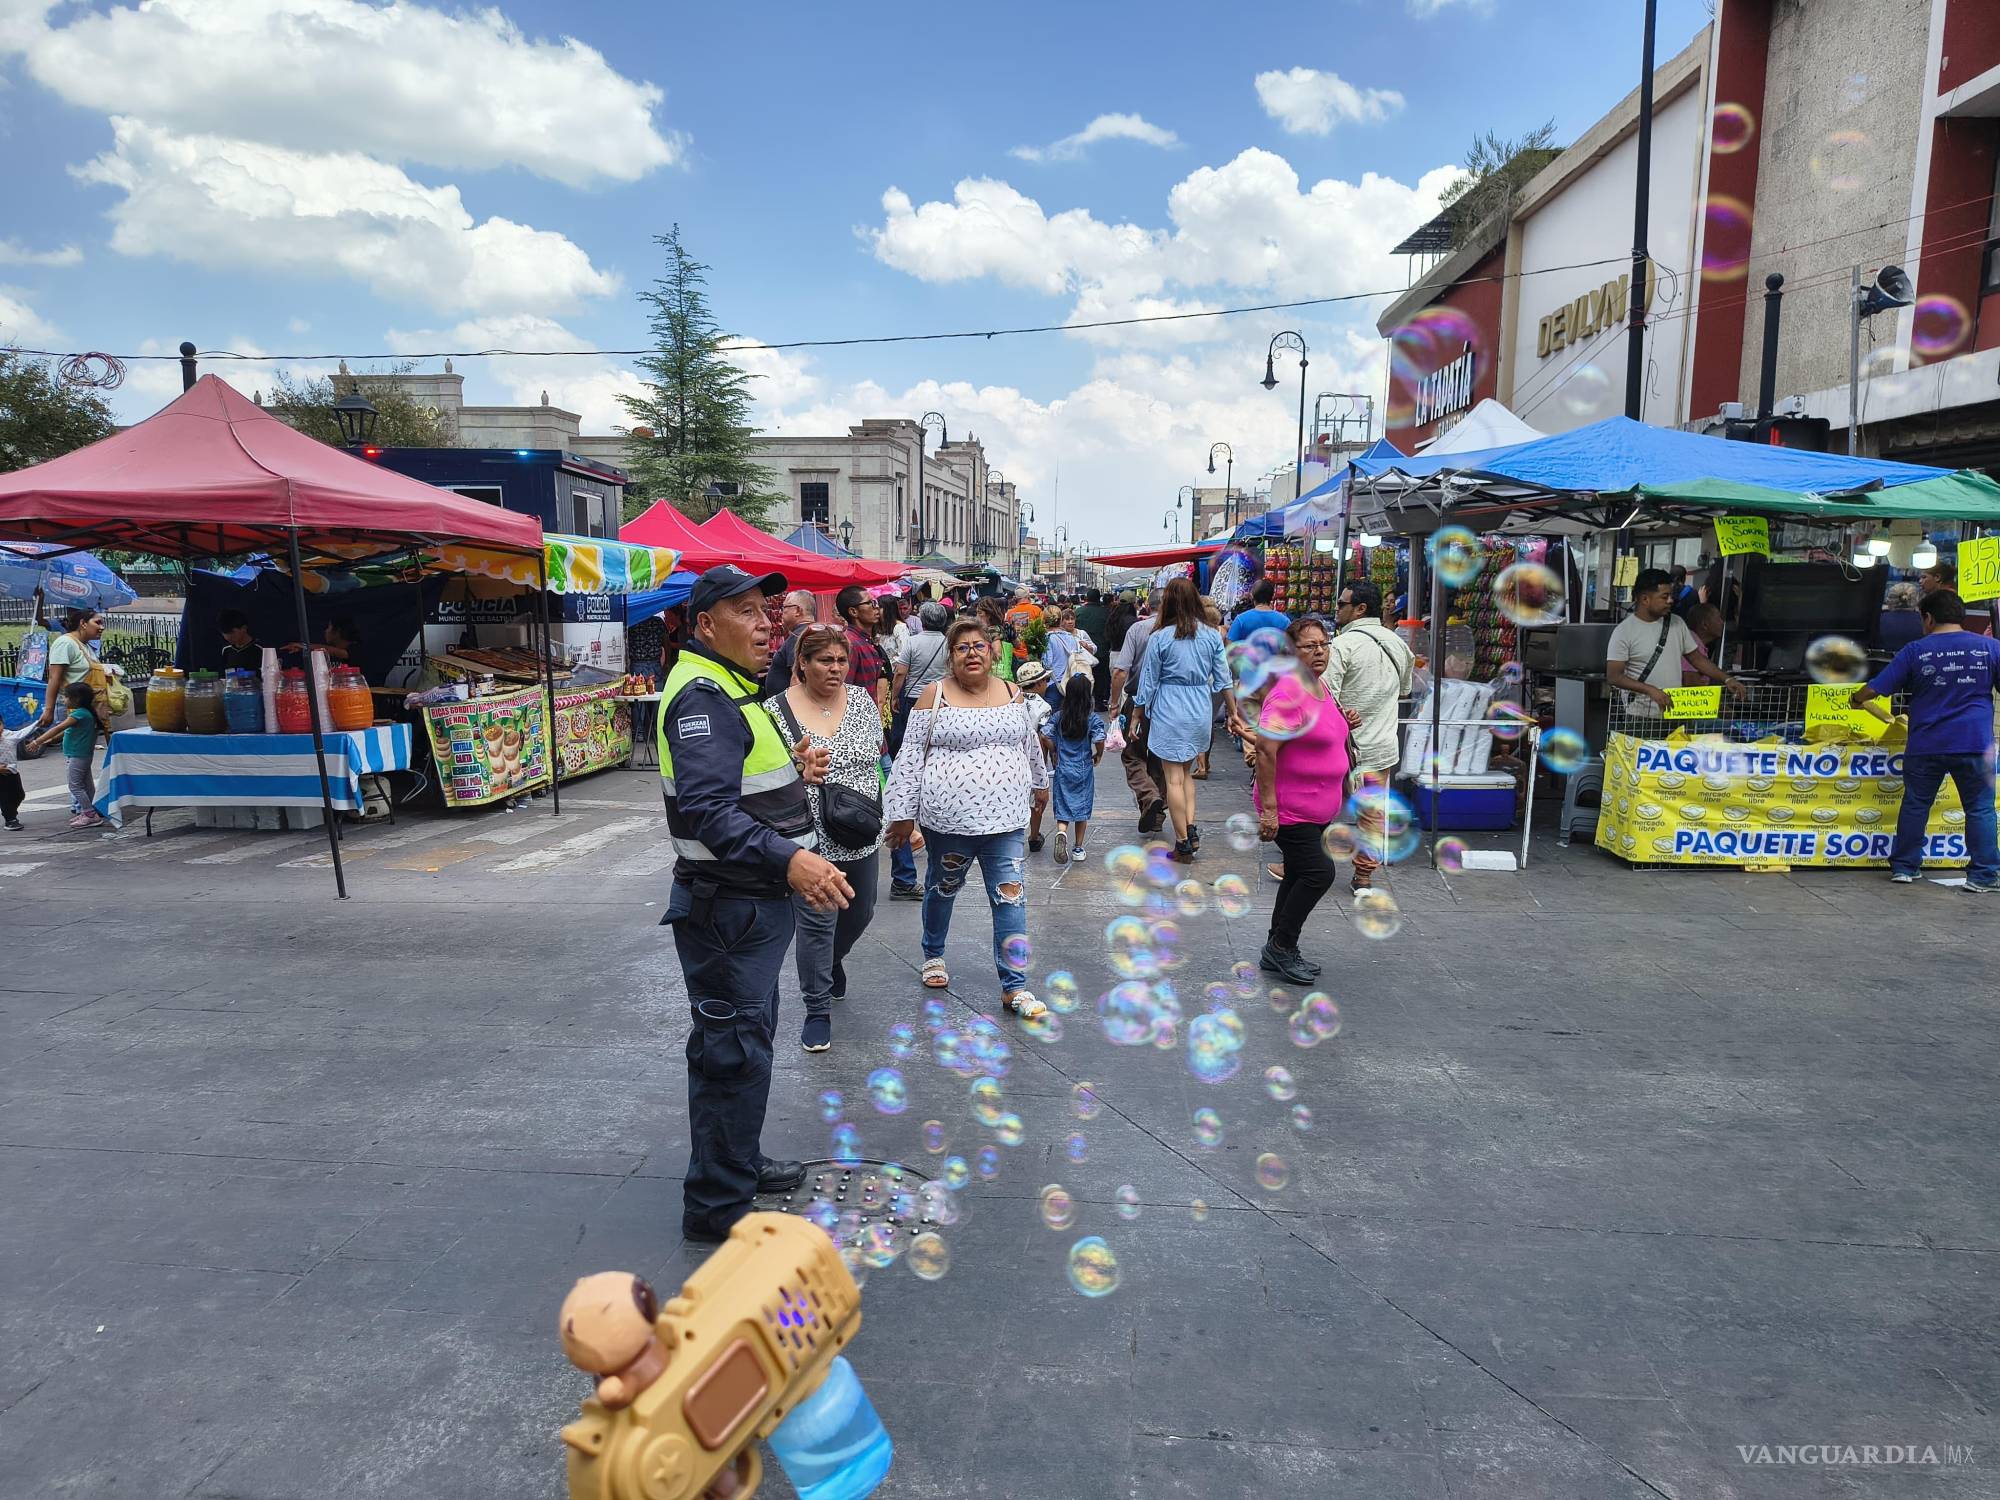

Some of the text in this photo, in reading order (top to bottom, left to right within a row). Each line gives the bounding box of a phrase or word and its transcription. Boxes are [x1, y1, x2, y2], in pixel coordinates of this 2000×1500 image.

[1537, 274, 1628, 358] DEVLYN
[1415, 340, 1473, 430] LA TAPATÍA
[1970, 540, 2000, 562] US
[454, 716, 469, 725] NATA
[1637, 747, 1777, 775] PAQUETE
[1788, 754, 1838, 776] NO
[1850, 754, 1905, 776] REC
[1653, 789, 1686, 797] mercado
[1698, 791, 1731, 799] mercado
[1676, 831, 1815, 856] PAQUETE
